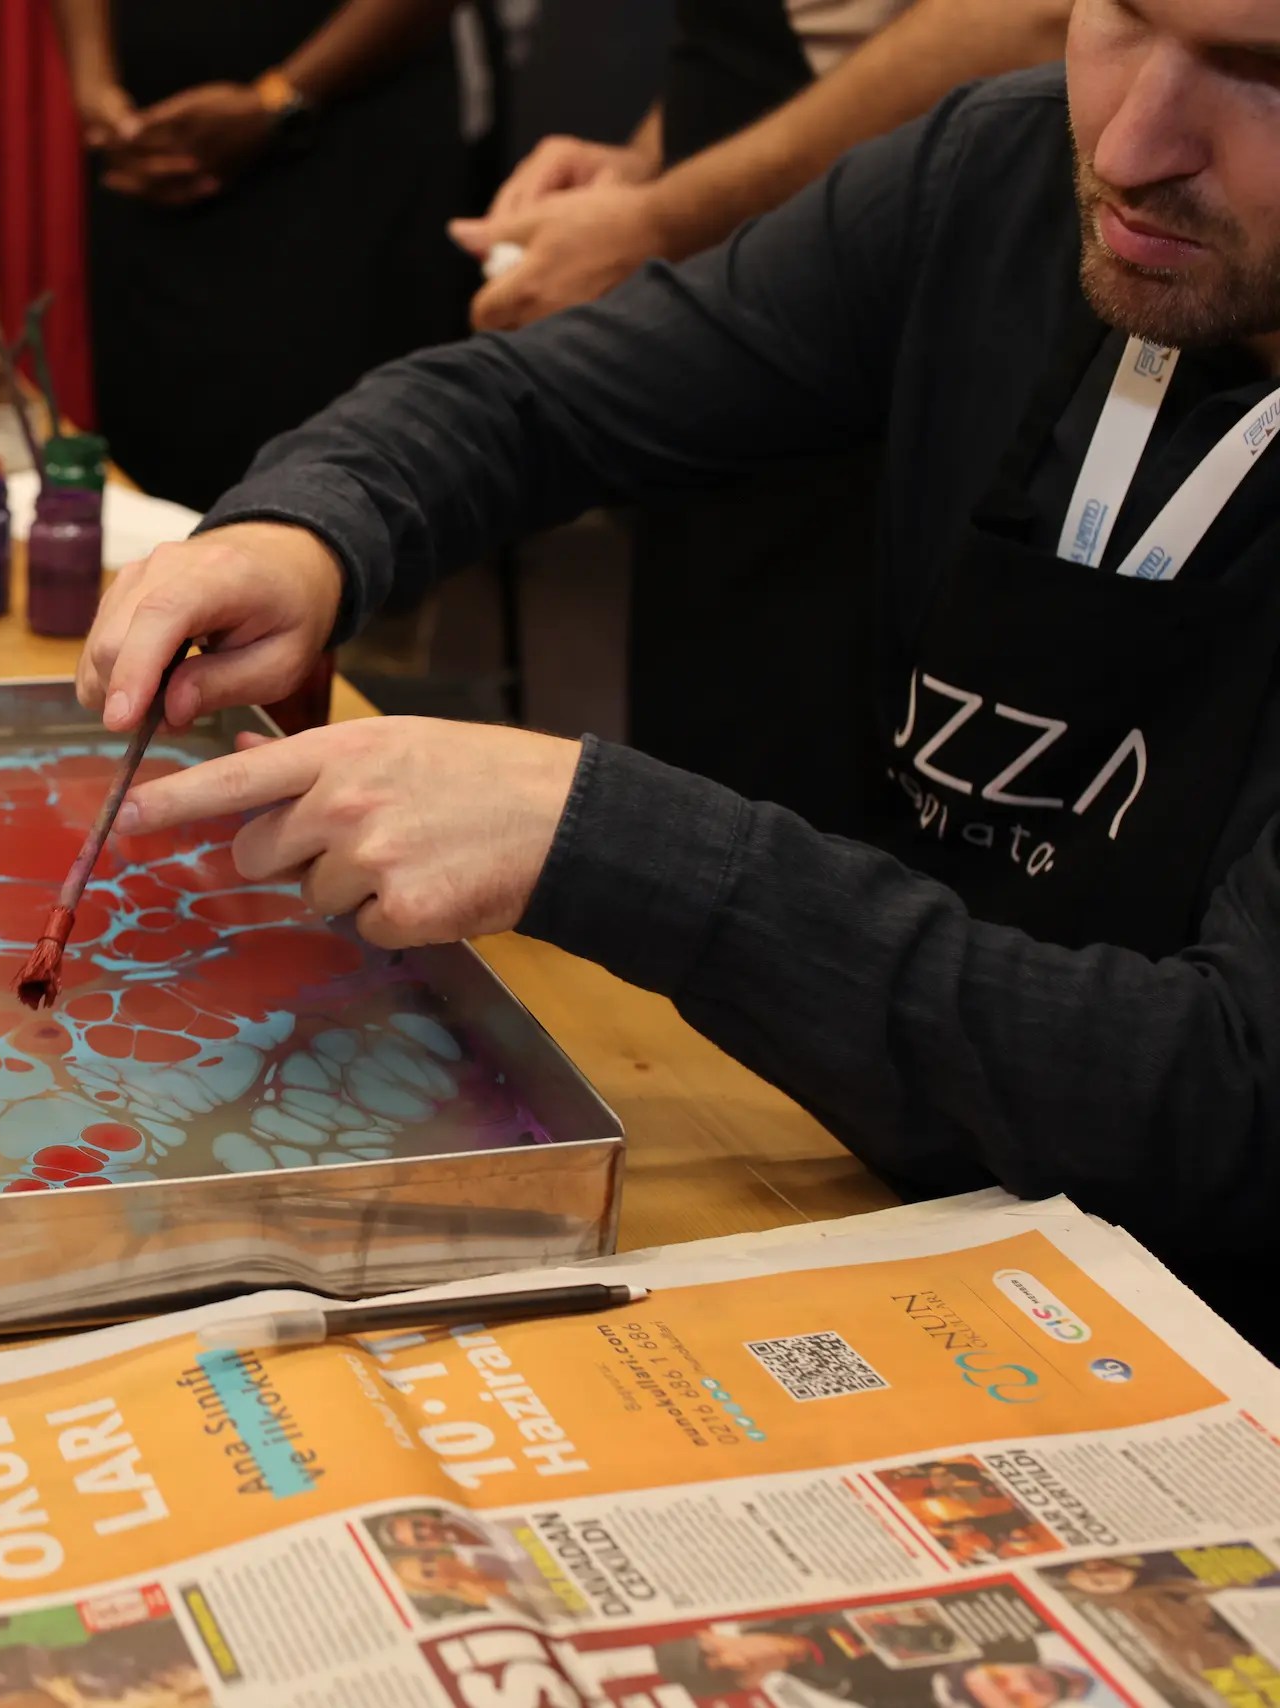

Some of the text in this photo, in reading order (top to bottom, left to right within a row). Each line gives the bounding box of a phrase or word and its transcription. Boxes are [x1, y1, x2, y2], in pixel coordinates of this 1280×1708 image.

[622, 1322, 658, 1351] 686
[890, 1294, 972, 1350] NUN
[597, 1324, 709, 1447] nunokullari.com
[692, 1404, 740, 1446] 0216
[45, 1397, 170, 1536] LARI
[224, 1440, 273, 1494] Ana
[290, 1449, 325, 1484] ve
